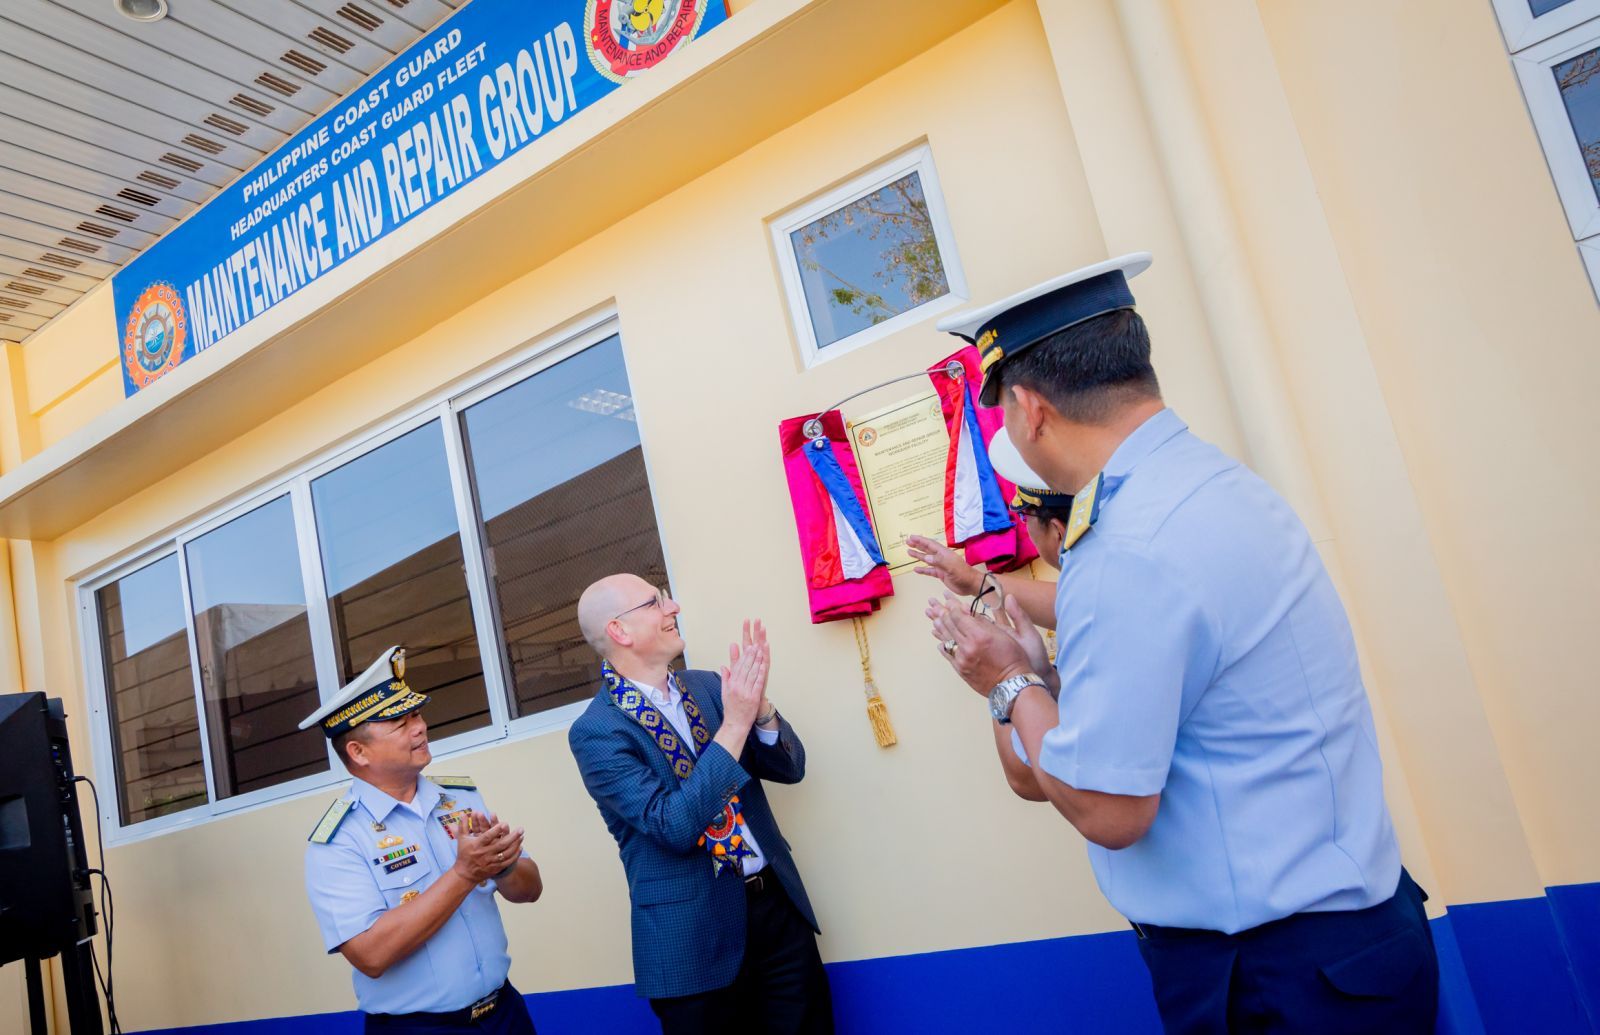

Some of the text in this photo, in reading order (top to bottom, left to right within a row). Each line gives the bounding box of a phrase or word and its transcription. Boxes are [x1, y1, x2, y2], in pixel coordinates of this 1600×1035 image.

[242, 28, 462, 203] PHILIPPINE COAST GUARD
[599, 9, 643, 66] MAINTENANCE
[644, 43, 667, 64] AND
[186, 21, 578, 354] MAINTENANCE AND REPAIR GROUP
[230, 42, 486, 241] HEADQUARTERS COAST GUARD FLEET
[128, 289, 184, 363] COAST GUARD
